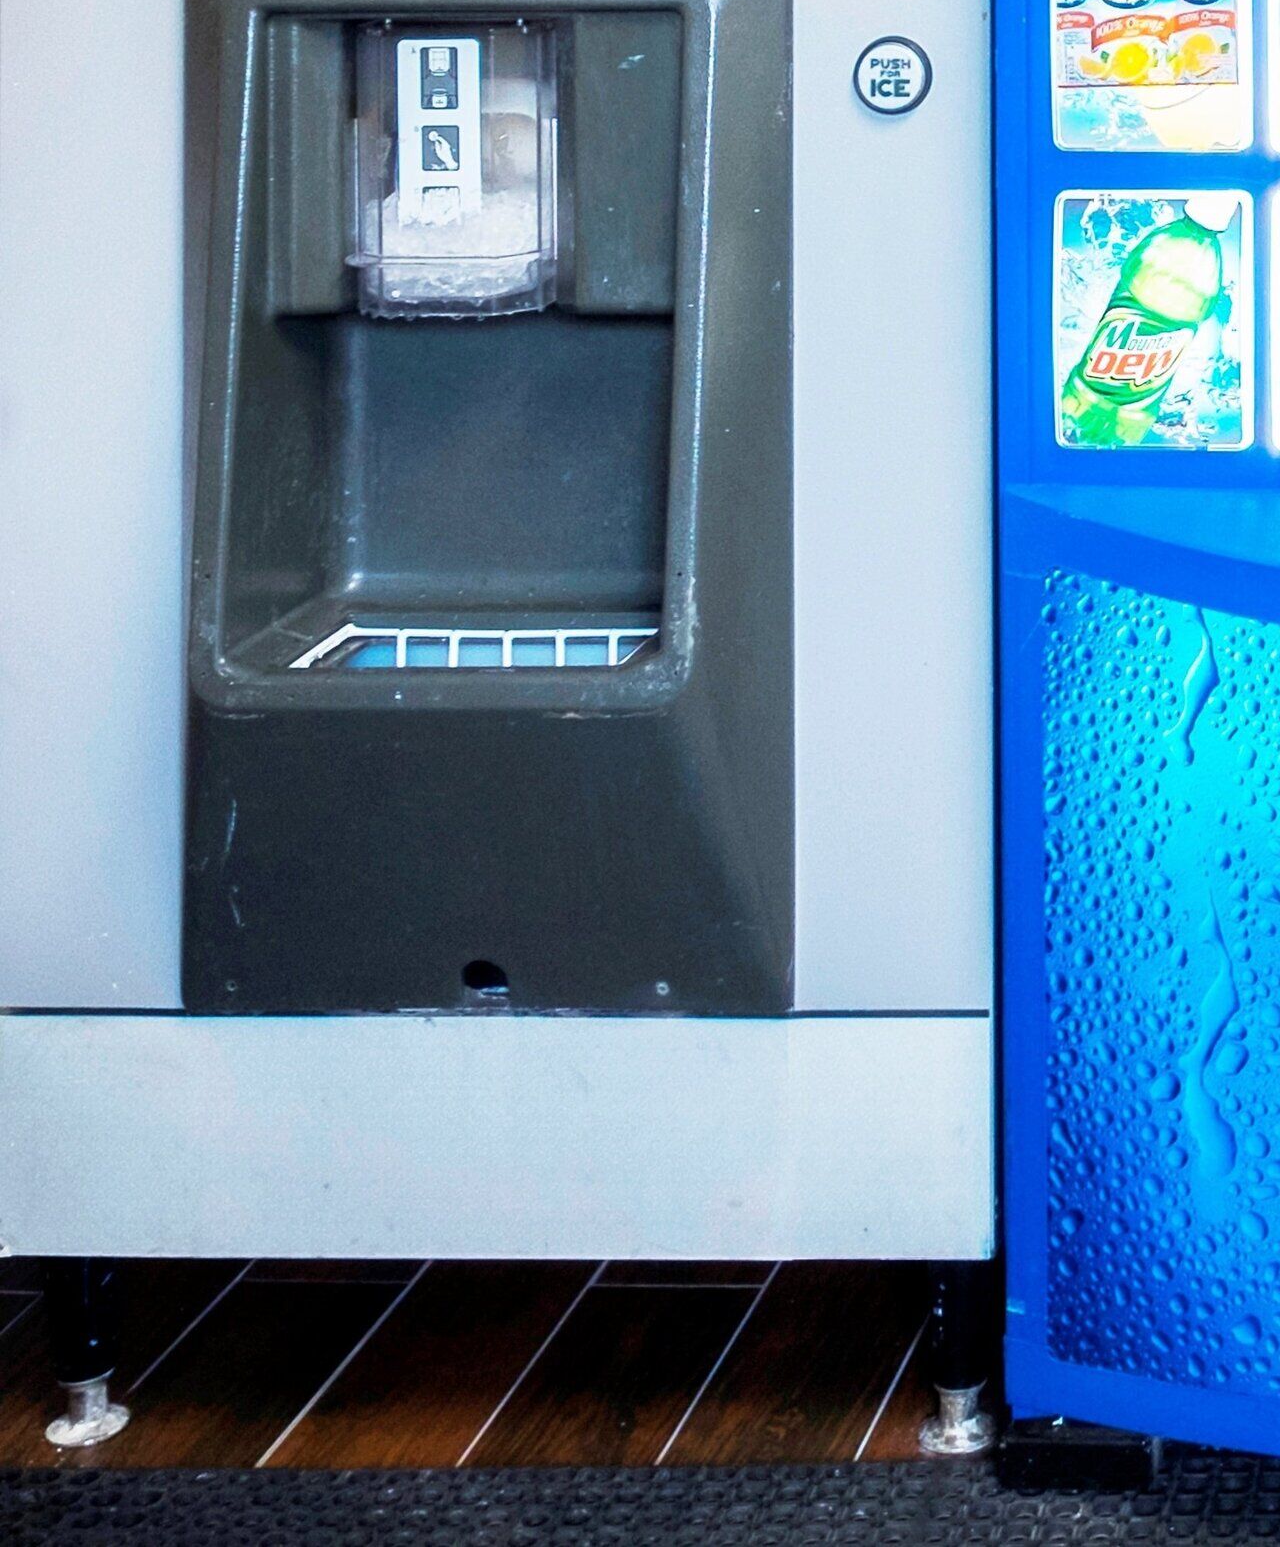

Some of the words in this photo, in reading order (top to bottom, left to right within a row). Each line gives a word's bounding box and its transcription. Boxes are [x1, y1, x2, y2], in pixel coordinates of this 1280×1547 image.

[870, 57, 911, 70] PUSH
[880, 70, 901, 78] FOR
[870, 79, 910, 98] ICE
